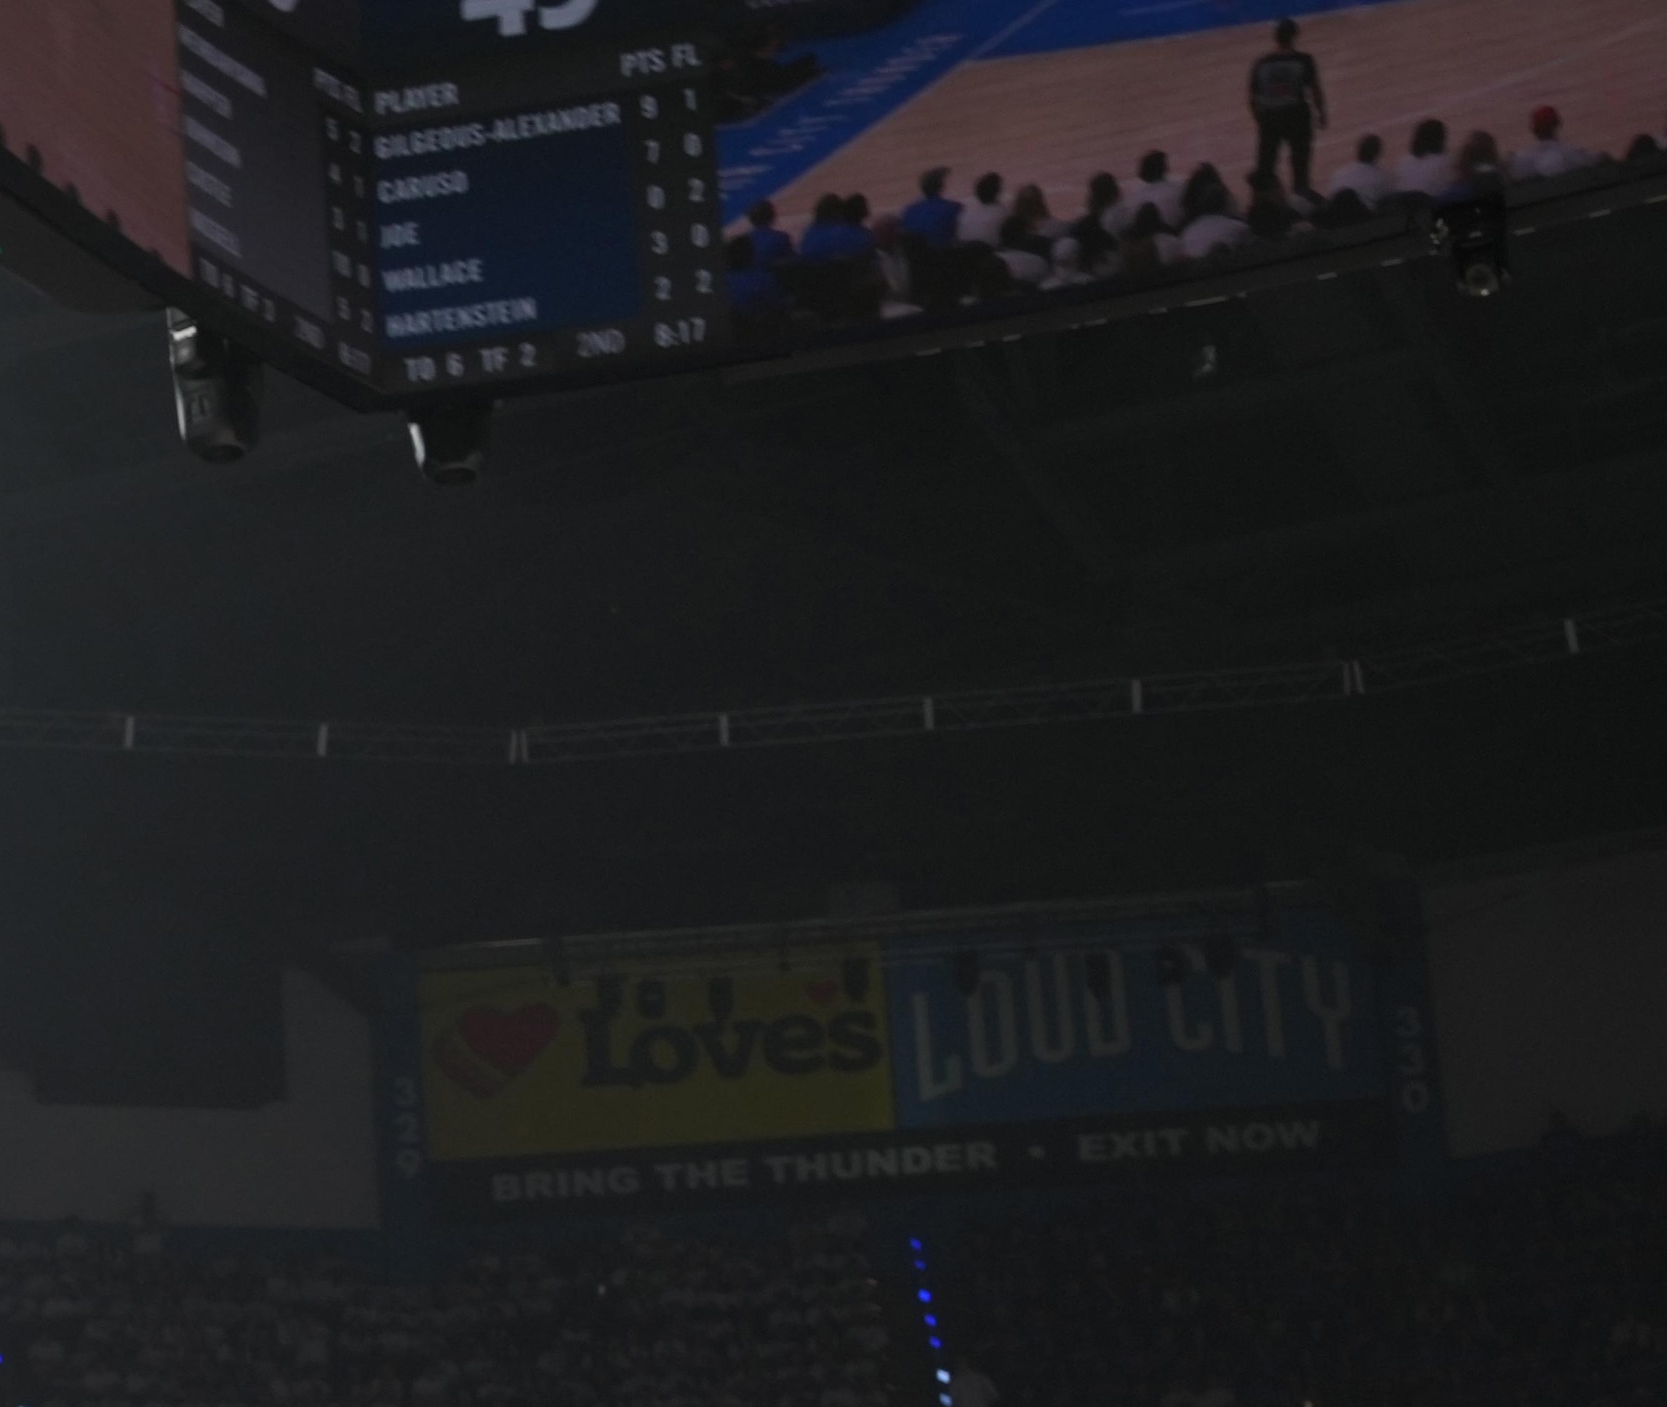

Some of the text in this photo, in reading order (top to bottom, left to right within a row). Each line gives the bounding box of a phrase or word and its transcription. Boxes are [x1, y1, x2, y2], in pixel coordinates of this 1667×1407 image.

[620, 42, 702, 77] PTS FL
[373, 82, 460, 116] PLAYER
[373, 101, 622, 160] GILGEOUS-ALEXANDER
[376, 169, 470, 204] CARUSO
[380, 257, 484, 292] WALLACE
[384, 296, 538, 338] HARTENSTEIN
[910, 942, 1352, 1102] LOUD CITY
[1395, 1004, 1431, 1115] 330
[393, 1074, 424, 1180] 329
[490, 1119, 1323, 1204] BRING THE THUNDER EXIT NOW
